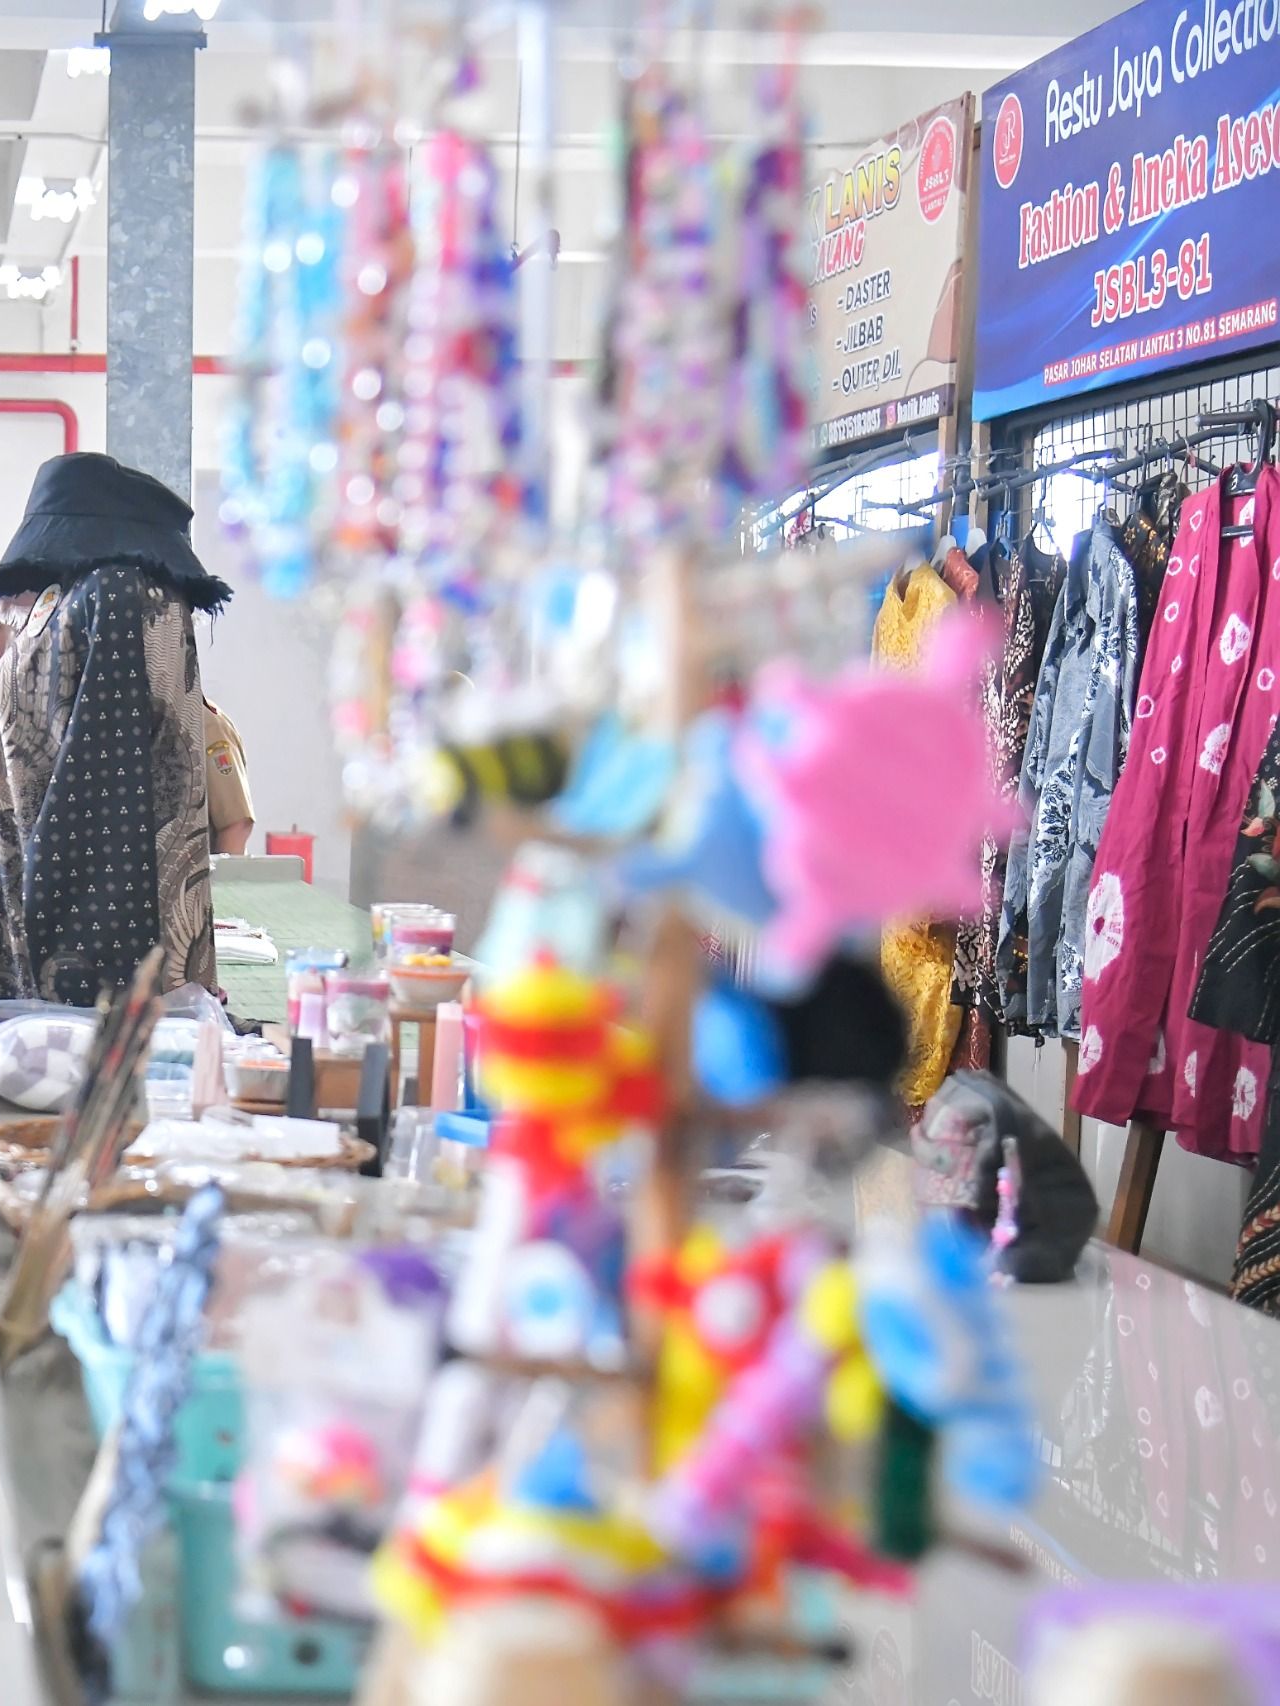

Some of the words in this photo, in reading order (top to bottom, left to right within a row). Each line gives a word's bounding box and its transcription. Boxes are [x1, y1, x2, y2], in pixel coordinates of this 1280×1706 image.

[1045, 70, 1102, 147] Restu
[1107, 45, 1163, 118] Jaya
[824, 145, 902, 235] LANIS
[1018, 182, 1099, 269] Fashion
[1104, 161, 1125, 234] &
[1128, 134, 1208, 226] Aneka
[846, 270, 890, 311] DASTER
[1091, 233, 1212, 327] JSBL3-81
[844, 315, 883, 352] JILBAB
[1044, 364, 1069, 384] PASAR
[1070, 355, 1097, 378] JOHAR
[1099, 342, 1138, 369] SELATAN
[1140, 335, 1174, 358] LANTAI
[1176, 332, 1183, 348] 3
[1185, 325, 1216, 346] NO.81
[1218, 302, 1276, 337] SEMARANG
